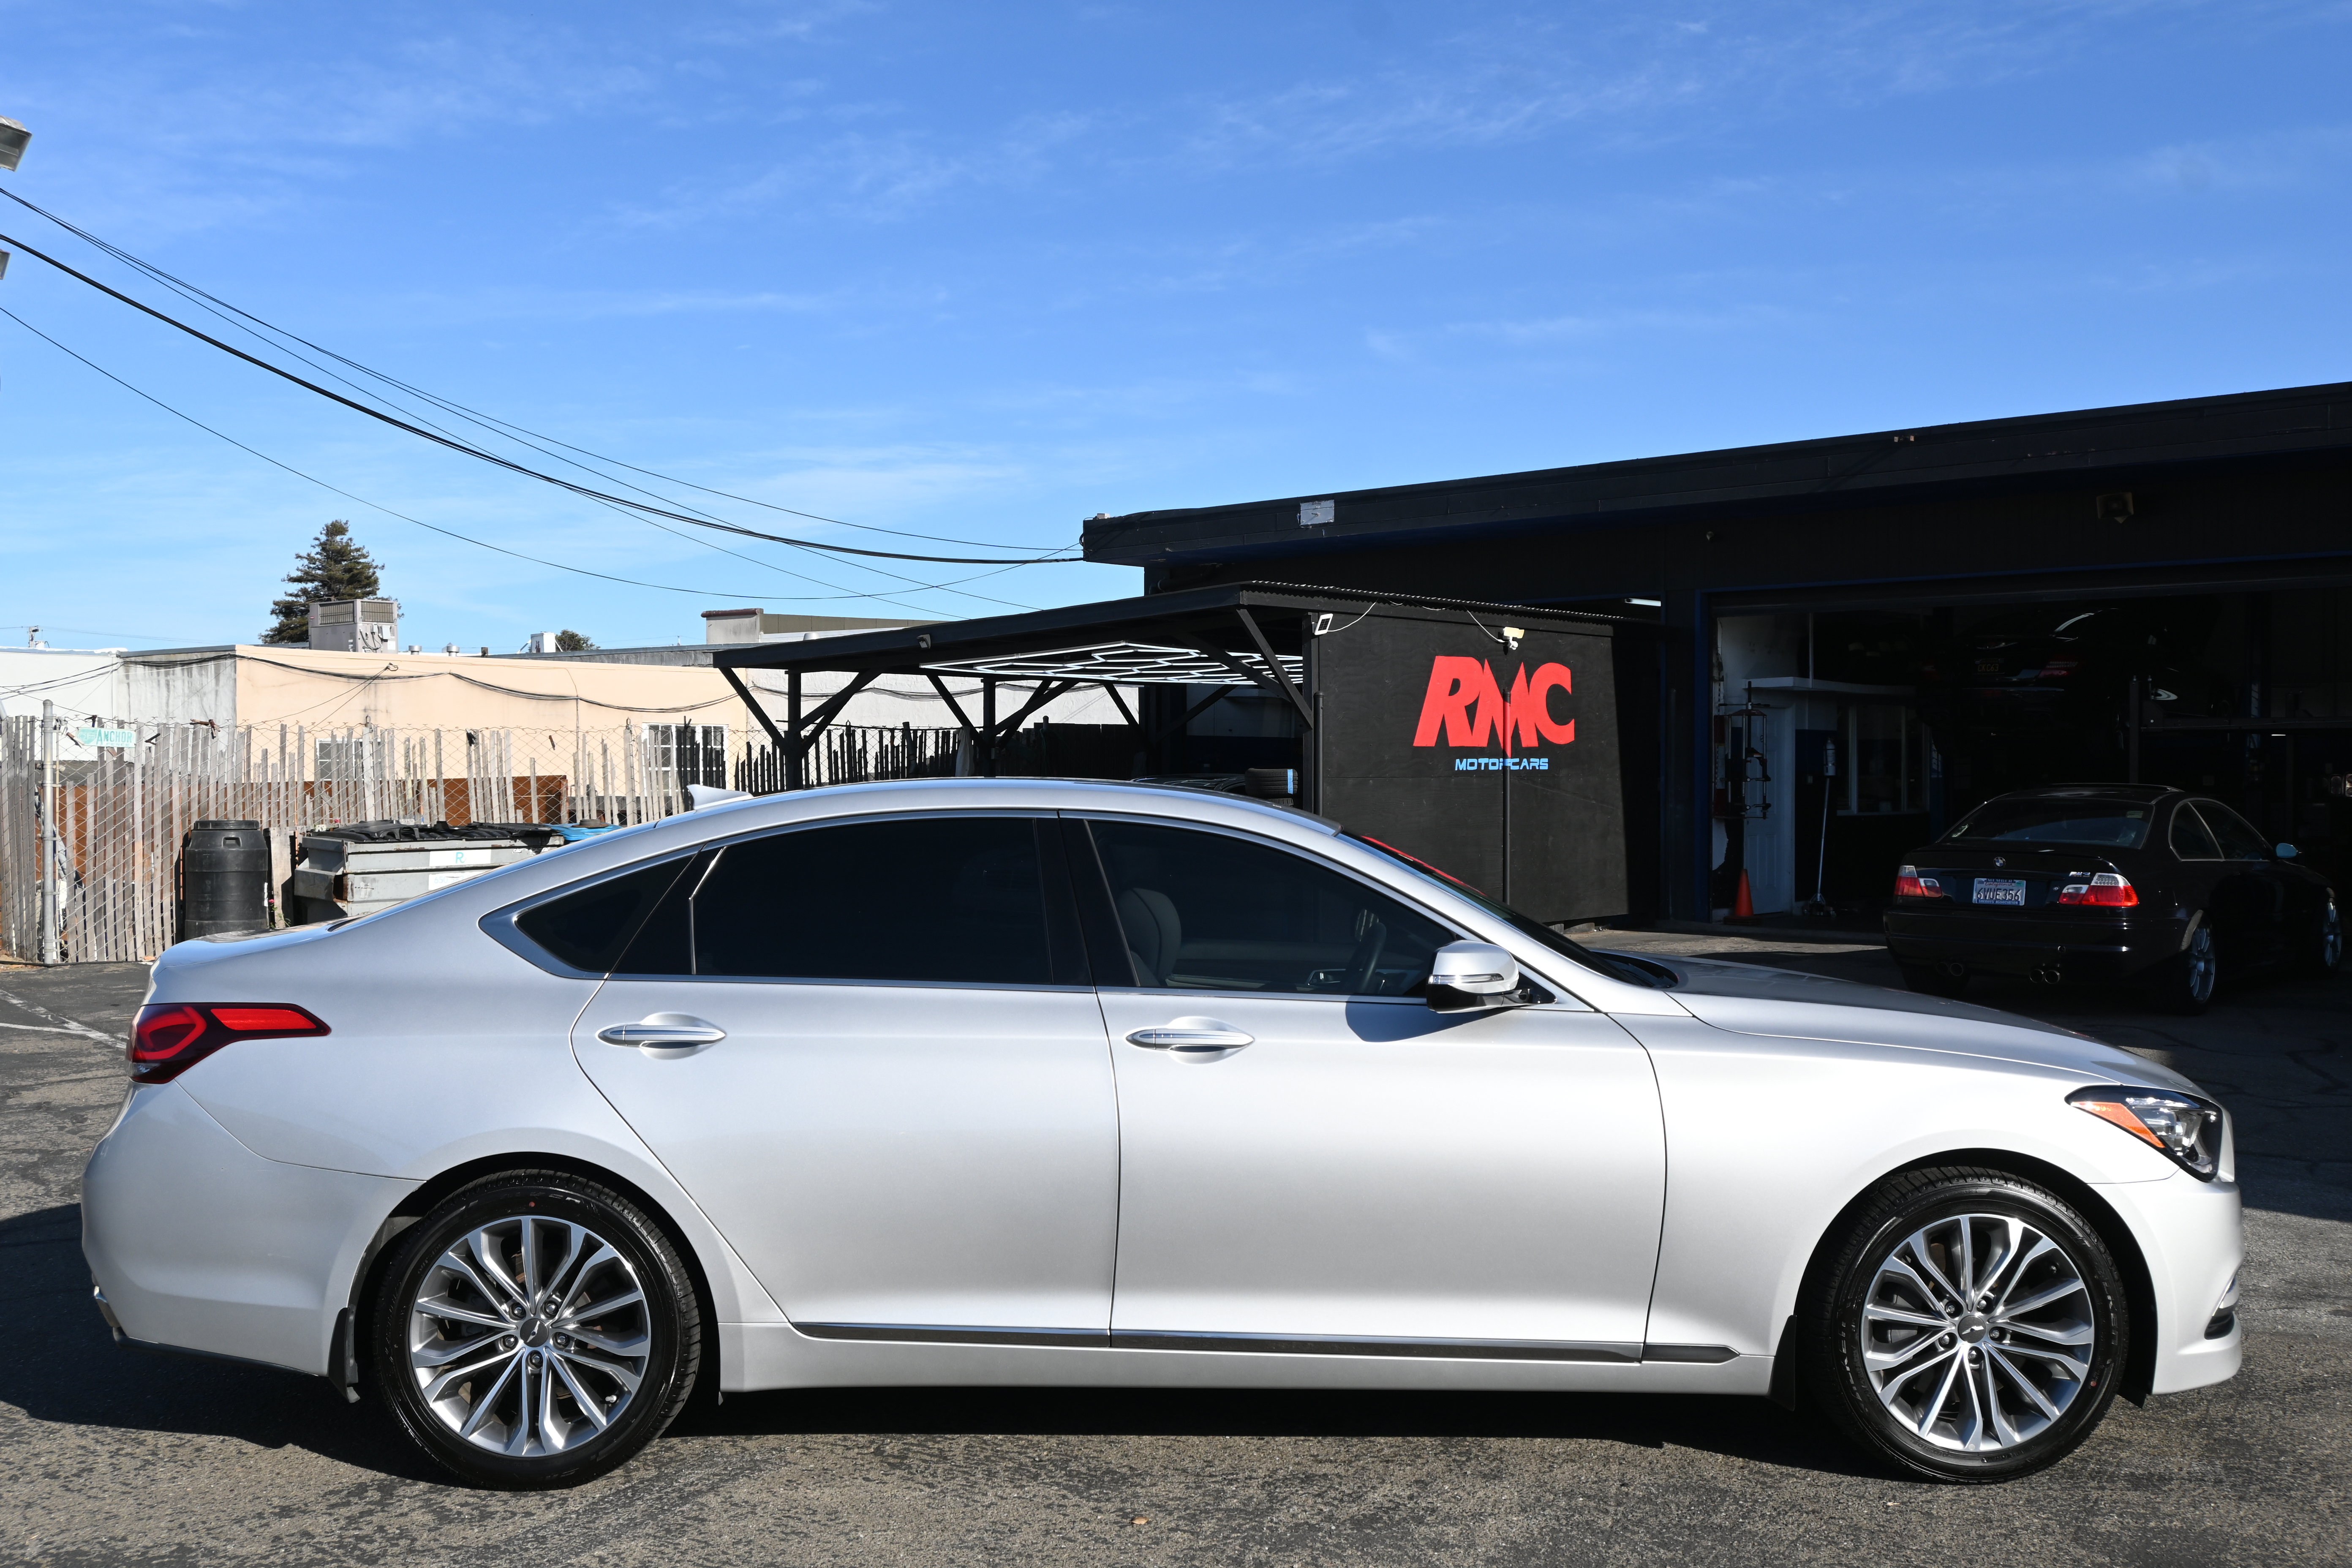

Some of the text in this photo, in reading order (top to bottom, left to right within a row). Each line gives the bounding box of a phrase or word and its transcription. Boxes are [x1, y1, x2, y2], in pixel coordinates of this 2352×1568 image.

[1413, 656, 1574, 752] RMC
[96, 729, 132, 745] ANCHOR
[1976, 888, 2022, 901] 6VUE356
